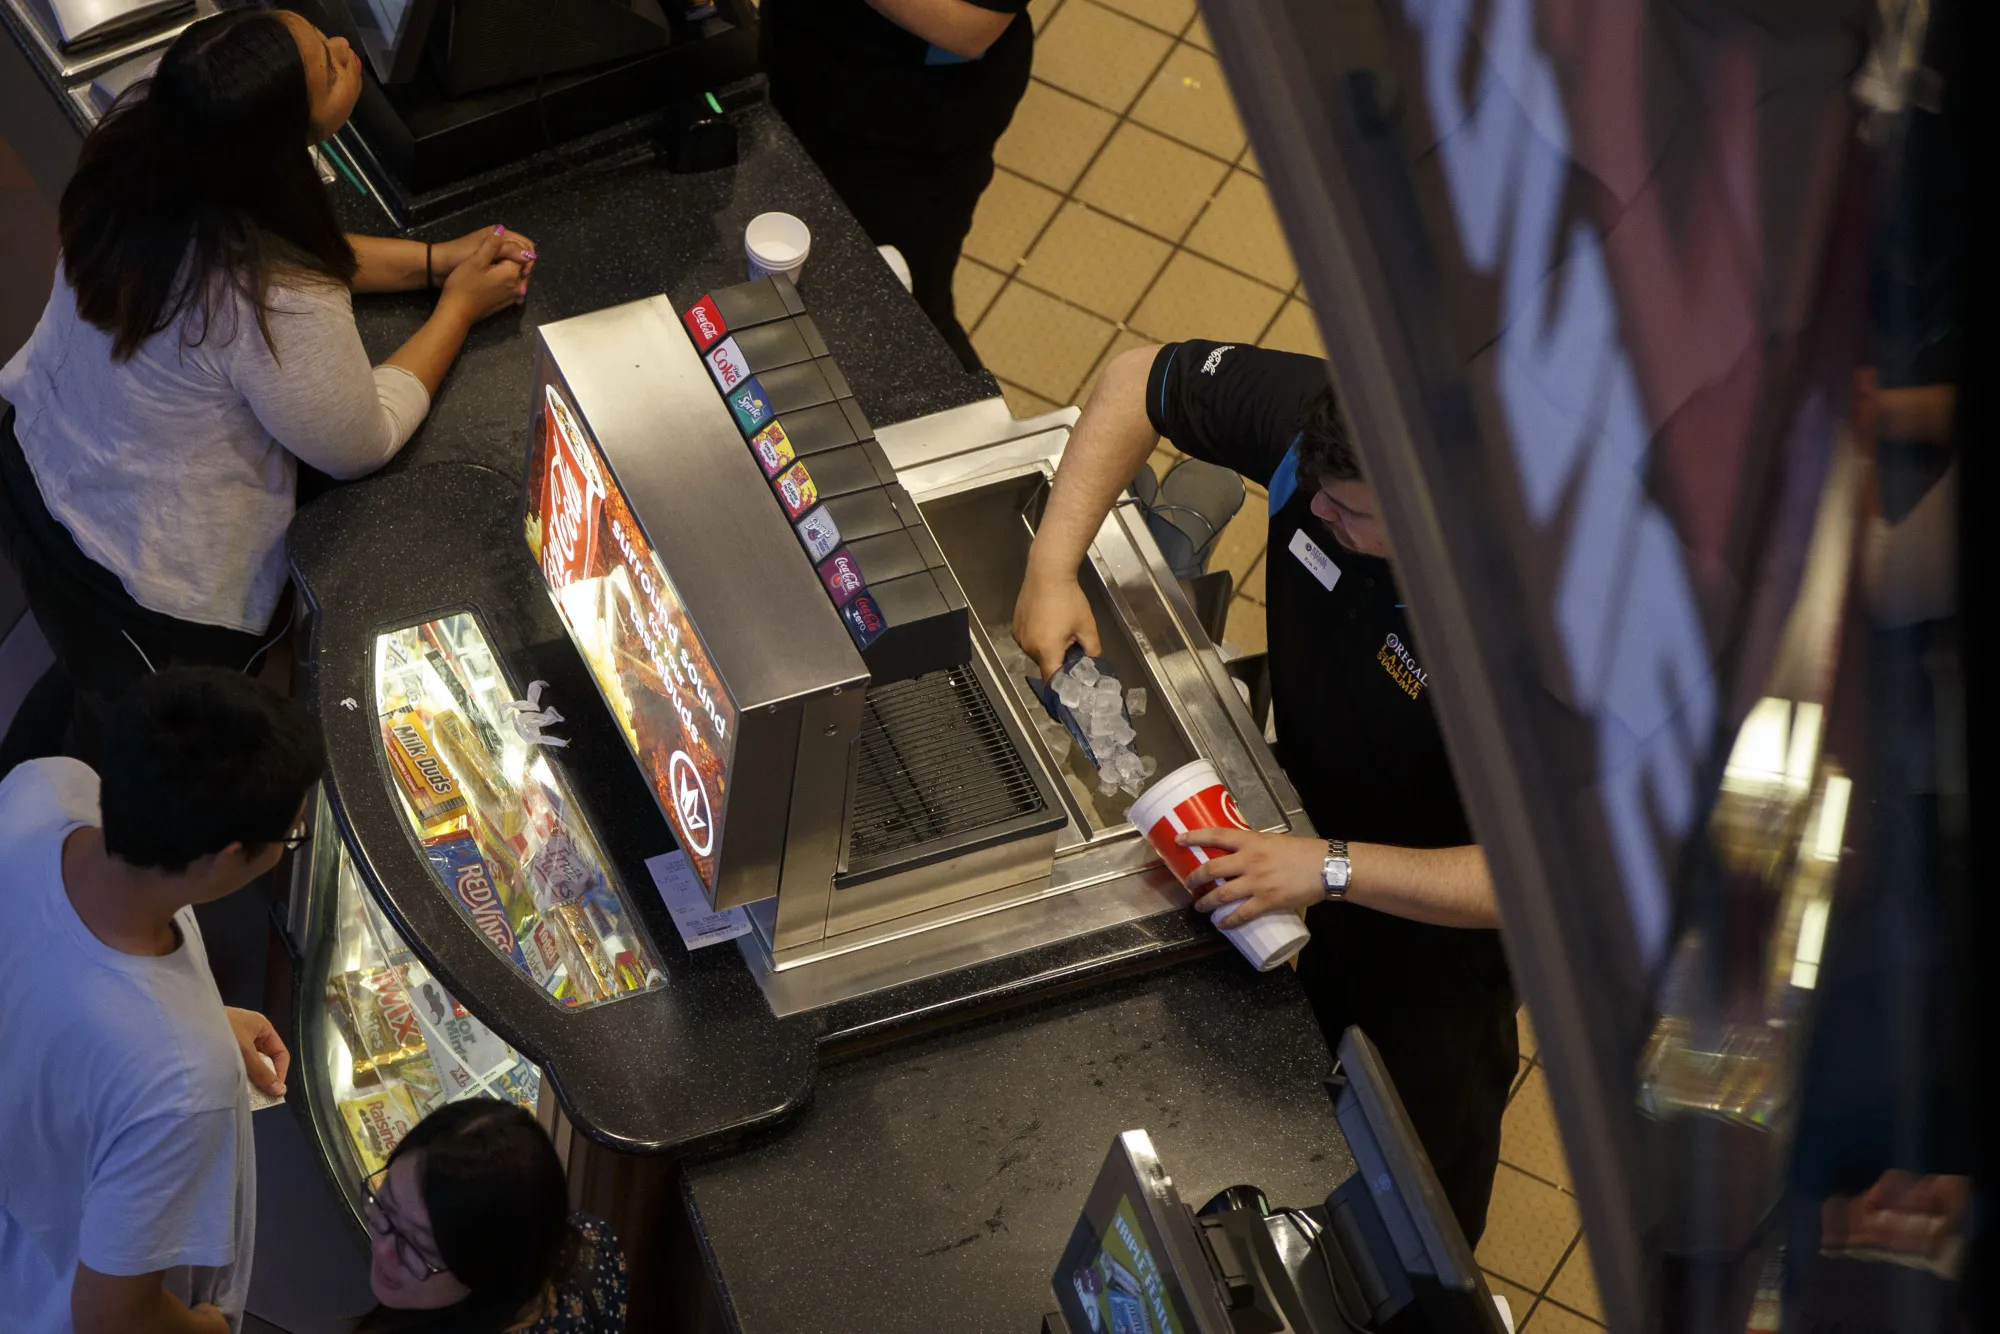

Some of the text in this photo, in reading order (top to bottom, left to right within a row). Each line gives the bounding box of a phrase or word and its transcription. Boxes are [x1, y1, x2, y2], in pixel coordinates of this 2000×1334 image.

[713, 347, 737, 387] Coke
[733, 365, 742, 378] Diet
[738, 396, 761, 417] Sprite
[611, 519, 726, 739] surround sound
[852, 610, 867, 632] zero
[648, 611, 686, 687] for your
[1394, 642, 1428, 687] REGAL
[629, 602, 699, 744] tastebuds
[1397, 663, 1422, 693] LIVE
[392, 723, 427, 758] Milk
[415, 756, 452, 794] Duds
[463, 1083, 481, 1096] Junio
[368, 1100, 398, 1151] Raisine
[1114, 1212, 1145, 1276] TRIPLE
